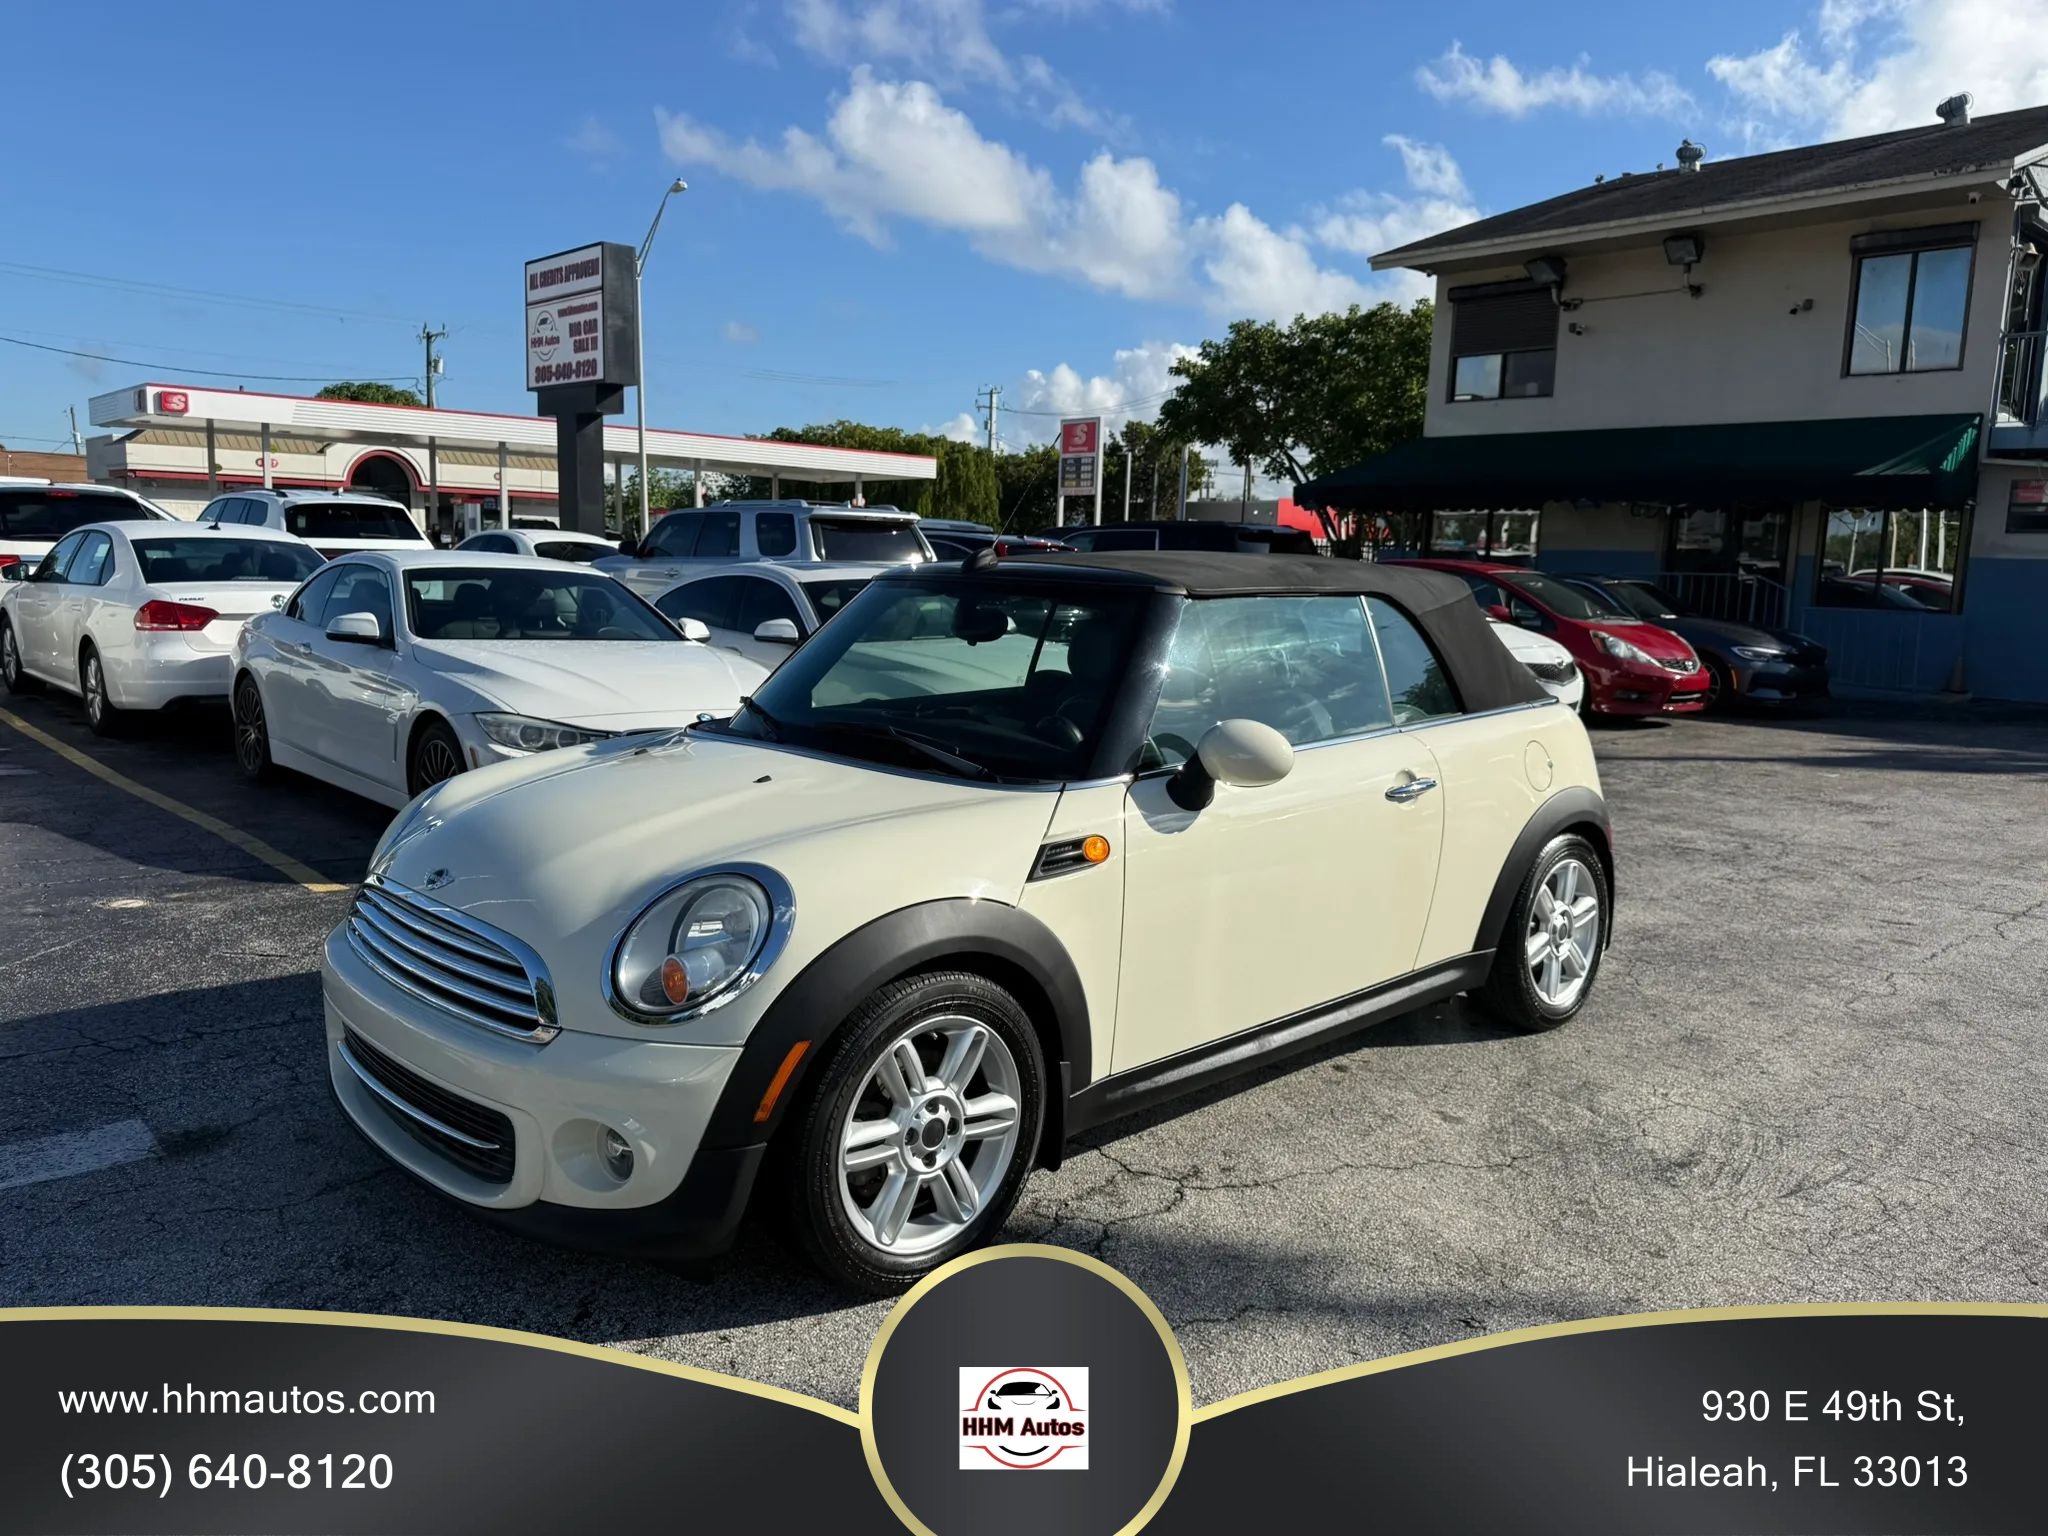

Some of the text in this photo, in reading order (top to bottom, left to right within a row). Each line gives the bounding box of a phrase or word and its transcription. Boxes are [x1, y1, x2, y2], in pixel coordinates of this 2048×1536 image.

[529, 272, 539, 291] ALL
[582, 317, 598, 336] CAR
[573, 336, 590, 354] SALE
[534, 357, 597, 384] 305-640-8120
